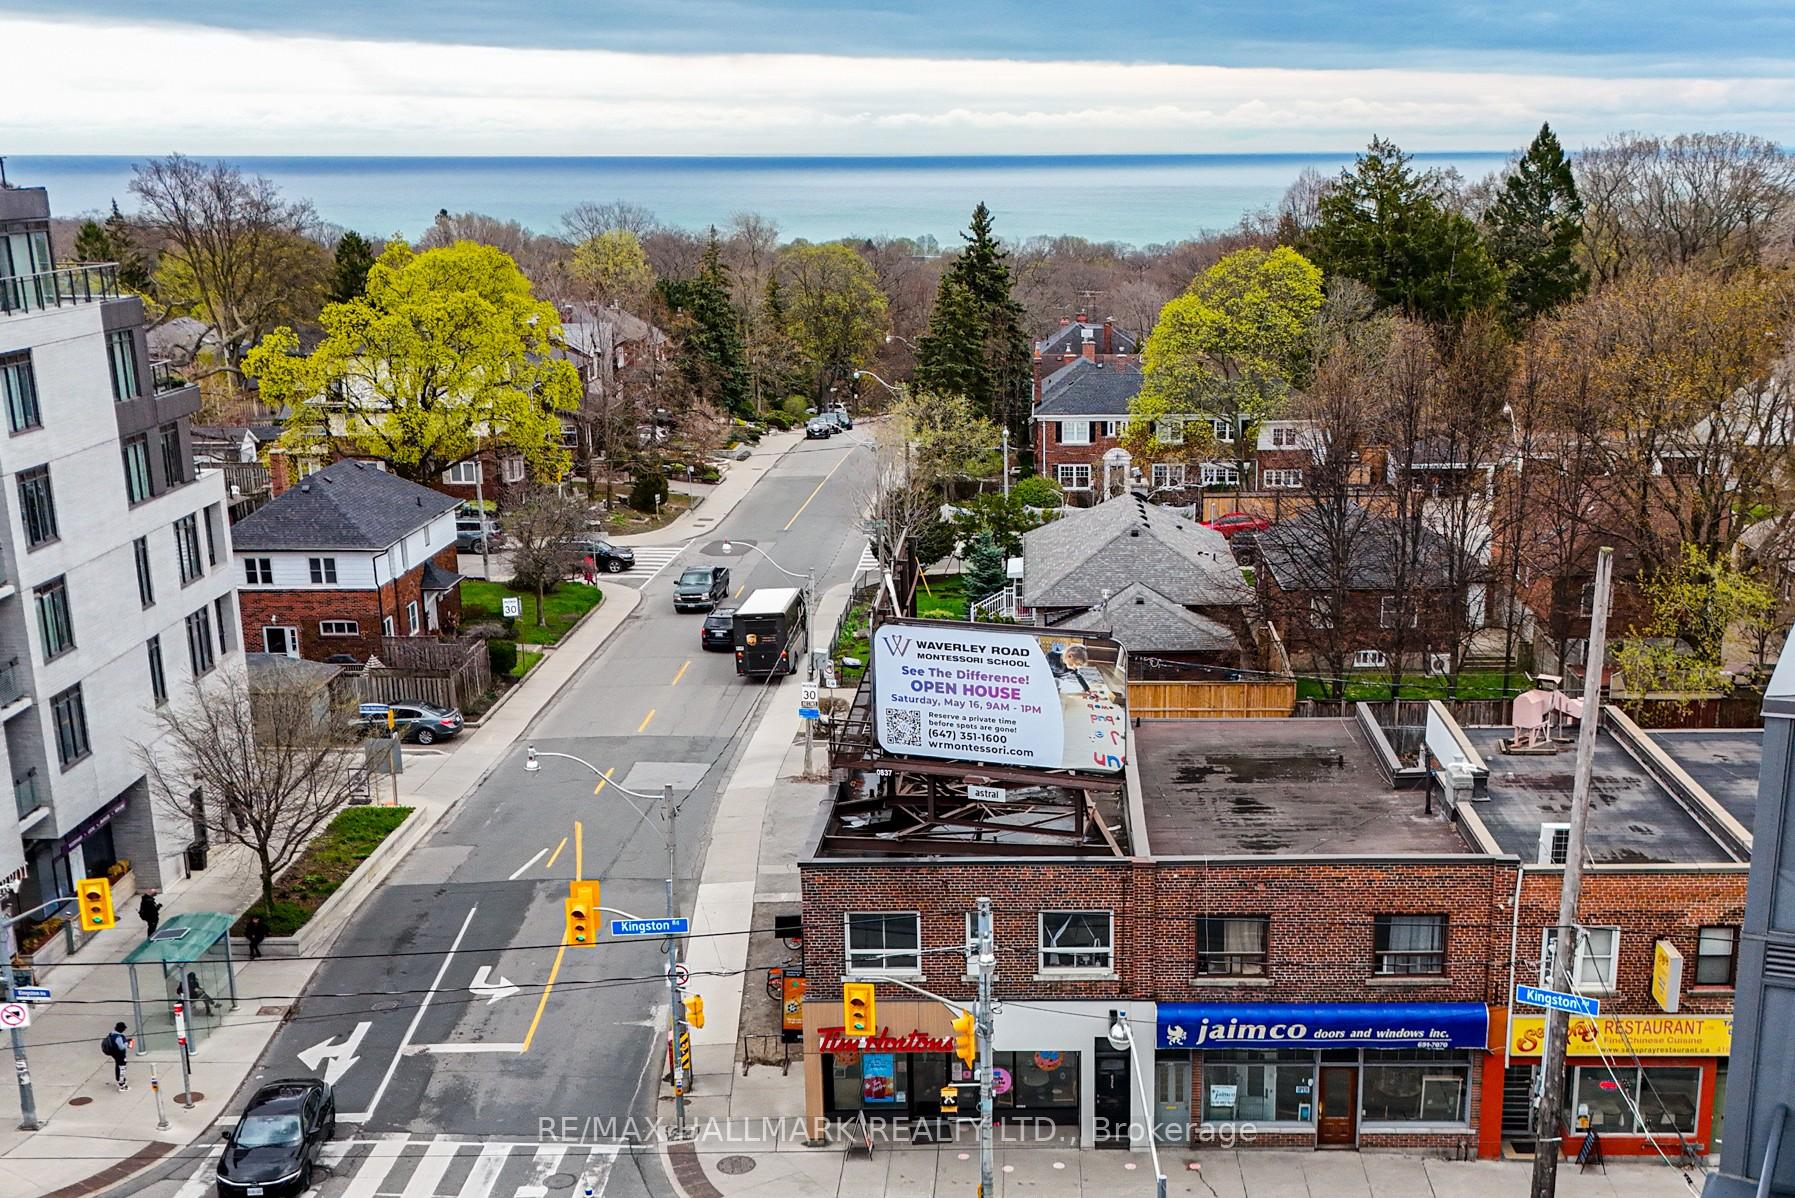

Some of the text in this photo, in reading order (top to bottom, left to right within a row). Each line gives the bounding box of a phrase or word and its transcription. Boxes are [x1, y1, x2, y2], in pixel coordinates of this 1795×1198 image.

[504, 605, 517, 614] 30
[916, 641, 1030, 657] WAVERLEY ROAD
[917, 652, 1030, 668] MONTESSORI SCHOOL
[901, 665, 1030, 685] See The Difference!
[803, 690, 816, 700] 30
[910, 680, 1021, 700] OPEN HOUSE
[891, 693, 941, 707] Saturday,
[944, 698, 966, 709] May
[968, 701, 983, 711] 16,
[985, 702, 1010, 712] 9AM
[1020, 704, 1042, 714] 1PM
[928, 711, 960, 721] Reserve
[968, 714, 997, 724] private
[998, 717, 1017, 726] time
[928, 719, 1017, 734] before spots are gone!
[928, 728, 1008, 744] (647) 351-1600
[928, 740, 1035, 757] wrmontessori.com
[974, 789, 999, 799] astral
[621, 921, 670, 934] Kingston
[1526, 989, 1577, 1009] Kingston
[1196, 1017, 1450, 1045] jaimco doors and windows inc.
[1604, 1020, 1705, 1035] RESTAURANT
[1666, 1036, 1703, 1044] Cuisine
